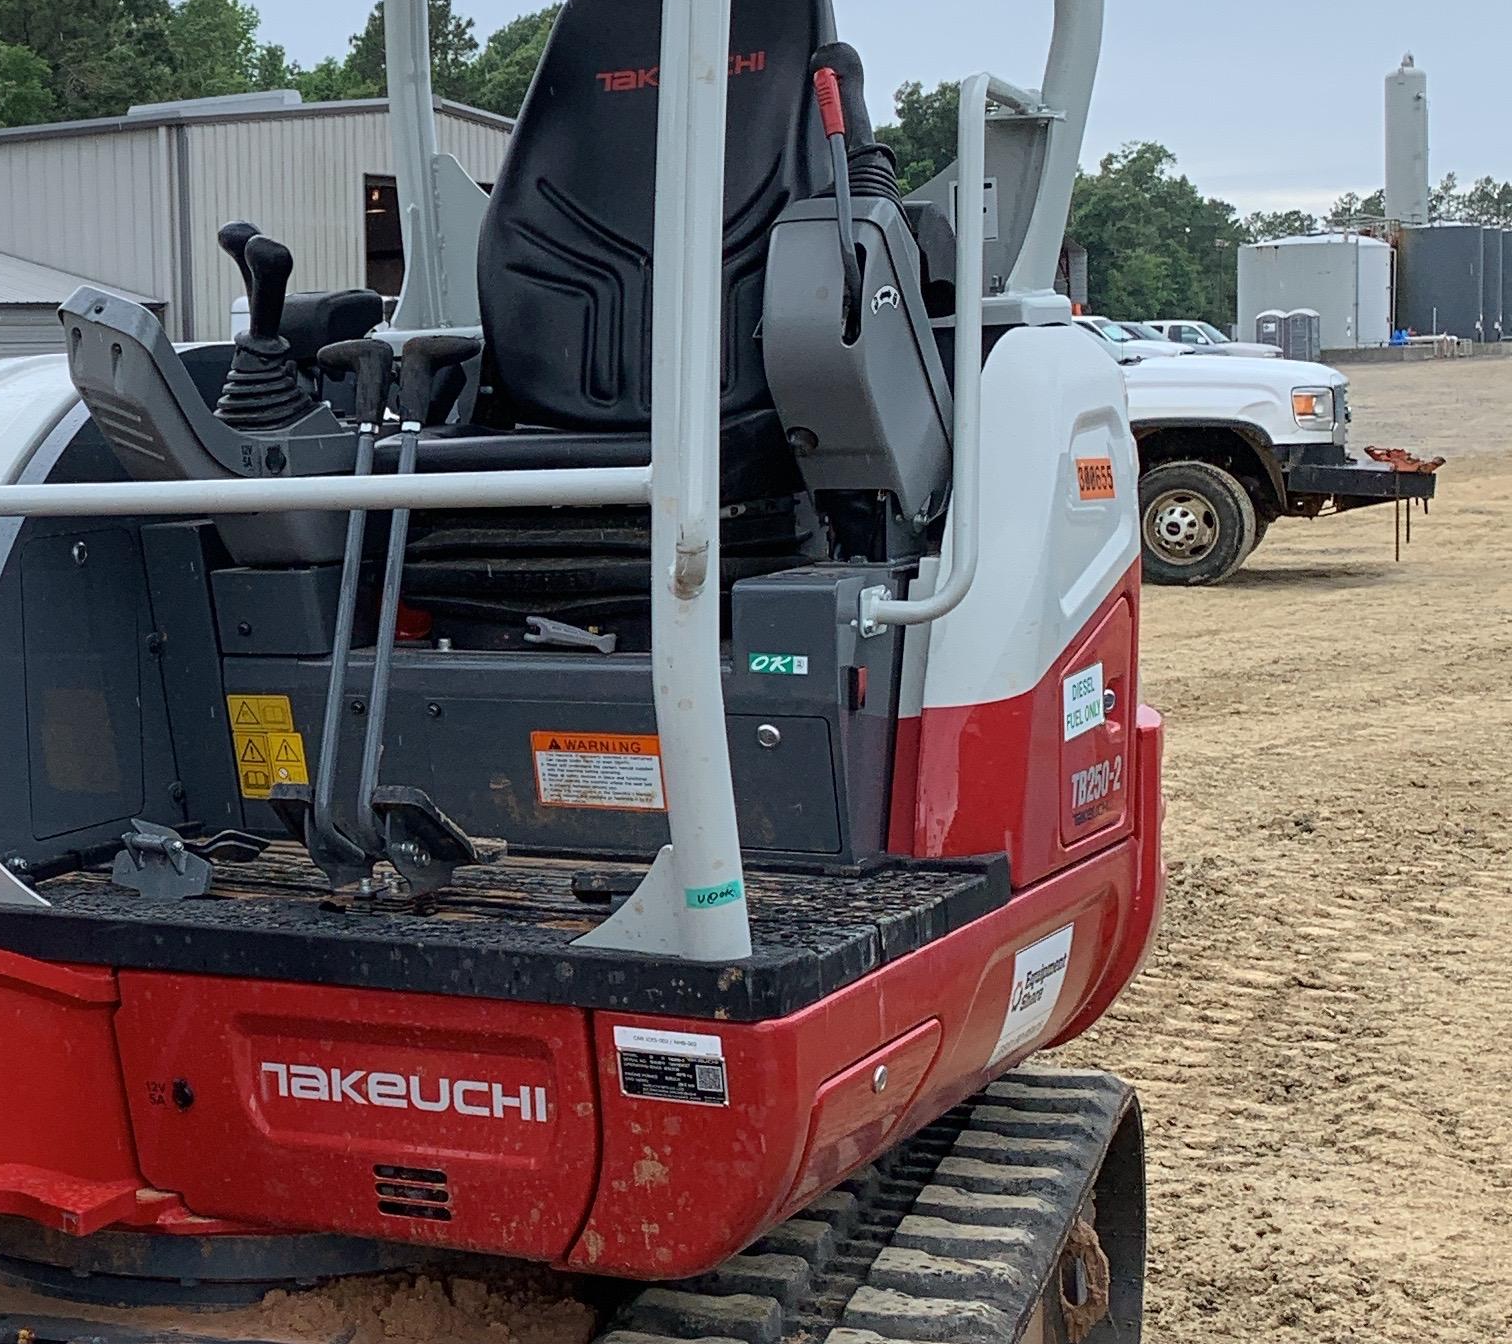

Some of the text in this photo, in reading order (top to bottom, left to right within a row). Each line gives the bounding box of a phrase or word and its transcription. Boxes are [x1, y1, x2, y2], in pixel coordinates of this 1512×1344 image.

[750, 655, 792, 672] OK
[1071, 676, 1095, 702] DIESEL
[1066, 698, 1101, 732] FUEL ONLY
[563, 739, 642, 753] WARNING
[1071, 755, 1122, 809] TB250-2
[1025, 952, 1067, 991] Equipment
[1019, 987, 1044, 1011] Share
[261, 1061, 548, 1123] TAKEUCHI
